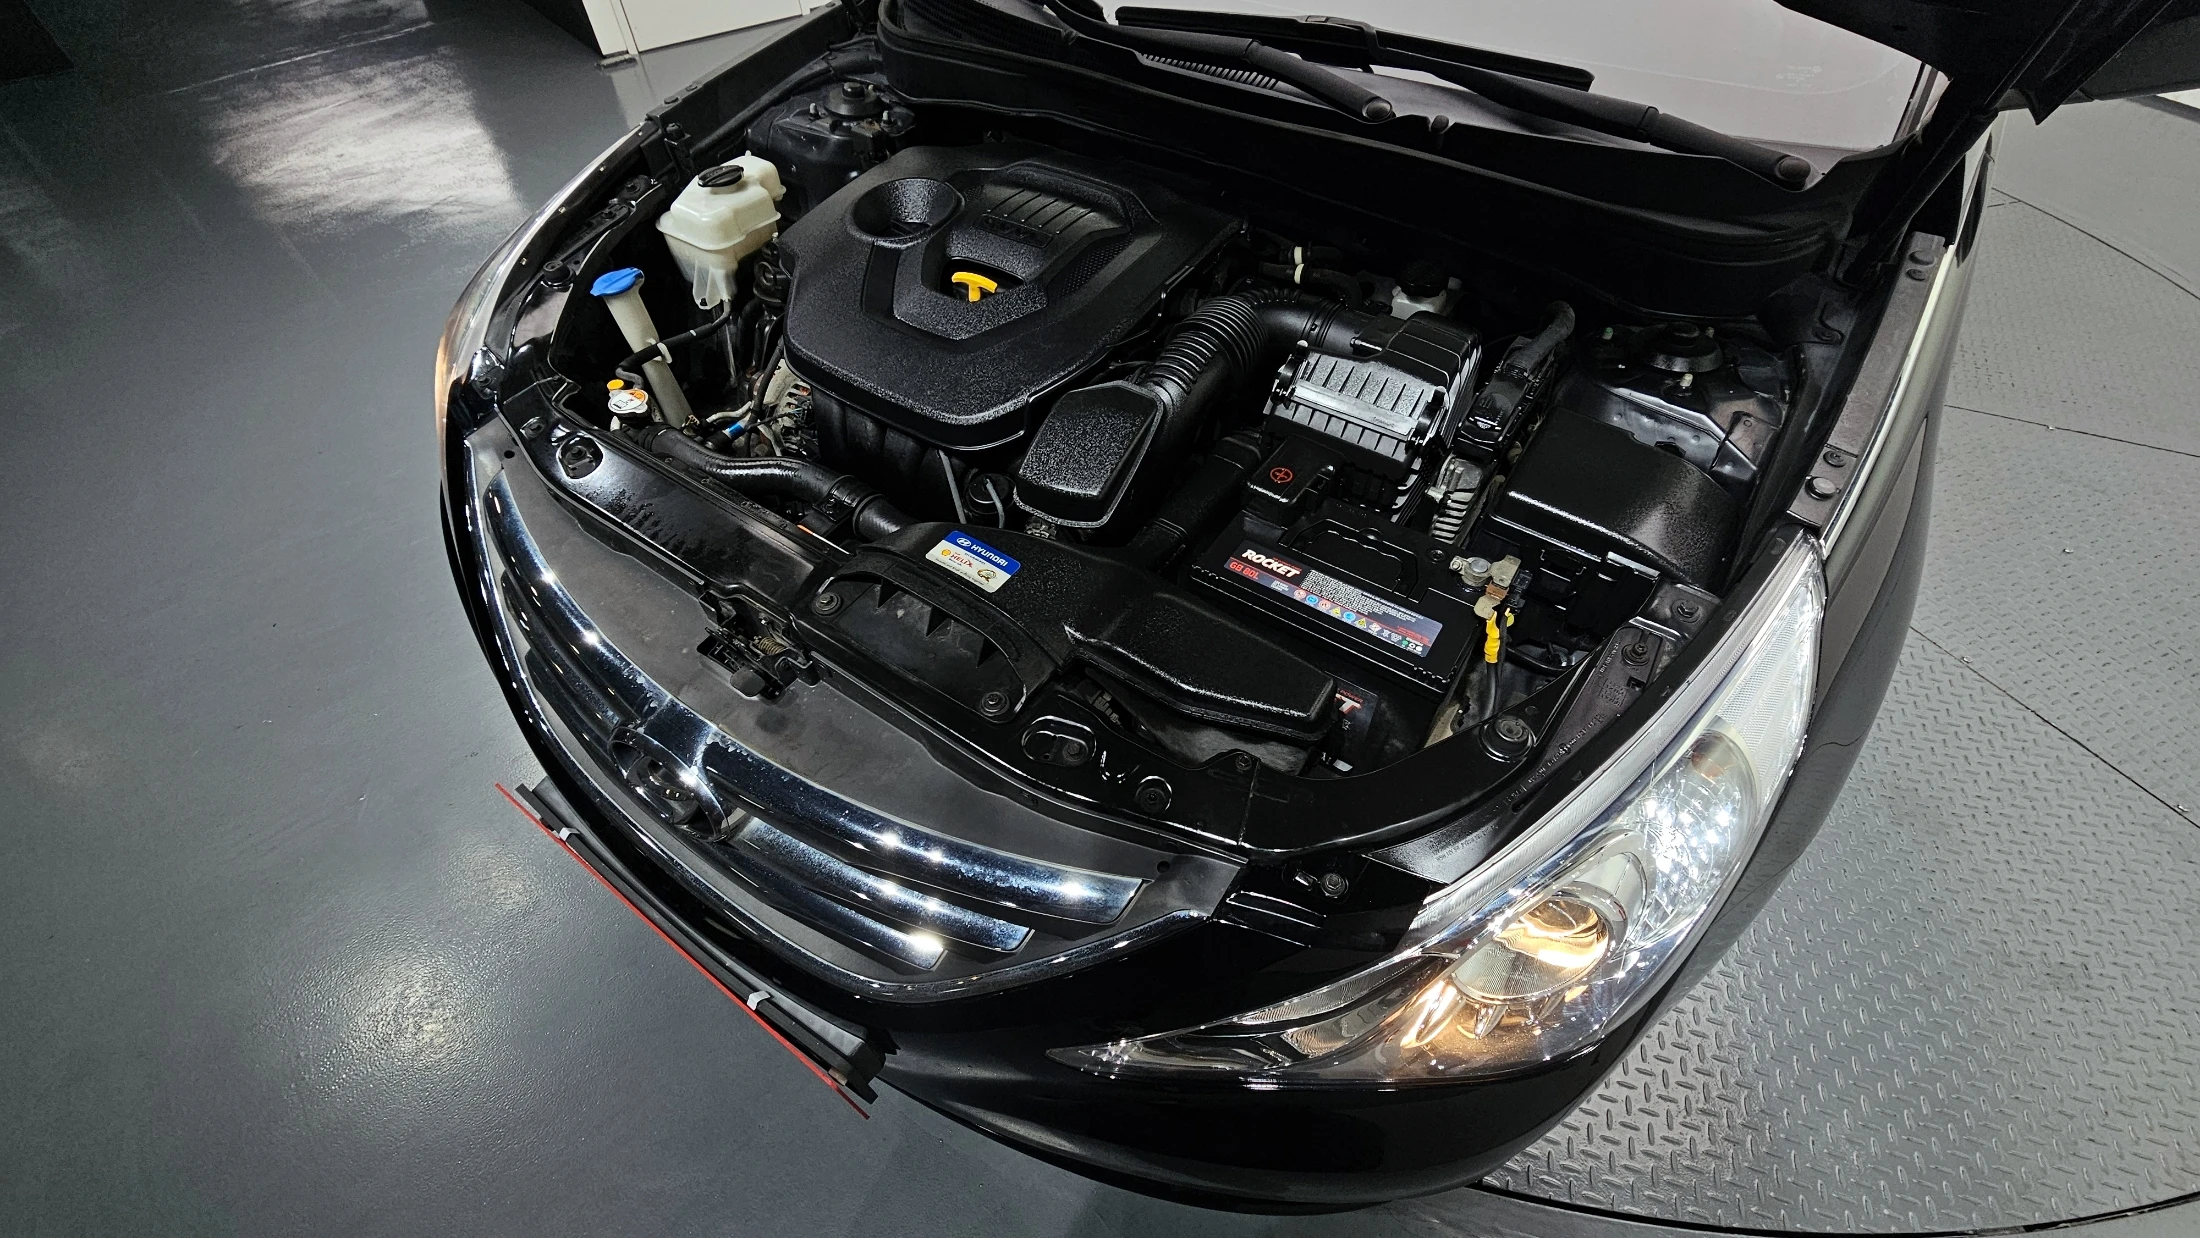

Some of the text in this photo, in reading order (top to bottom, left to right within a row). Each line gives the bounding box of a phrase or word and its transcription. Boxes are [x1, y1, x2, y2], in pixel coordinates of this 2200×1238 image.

[950, 553, 974, 568] HELIX
[970, 544, 1009, 567] HYUNDAI
[1241, 549, 1301, 578] ROCKET
[1229, 561, 1243, 572] GB
